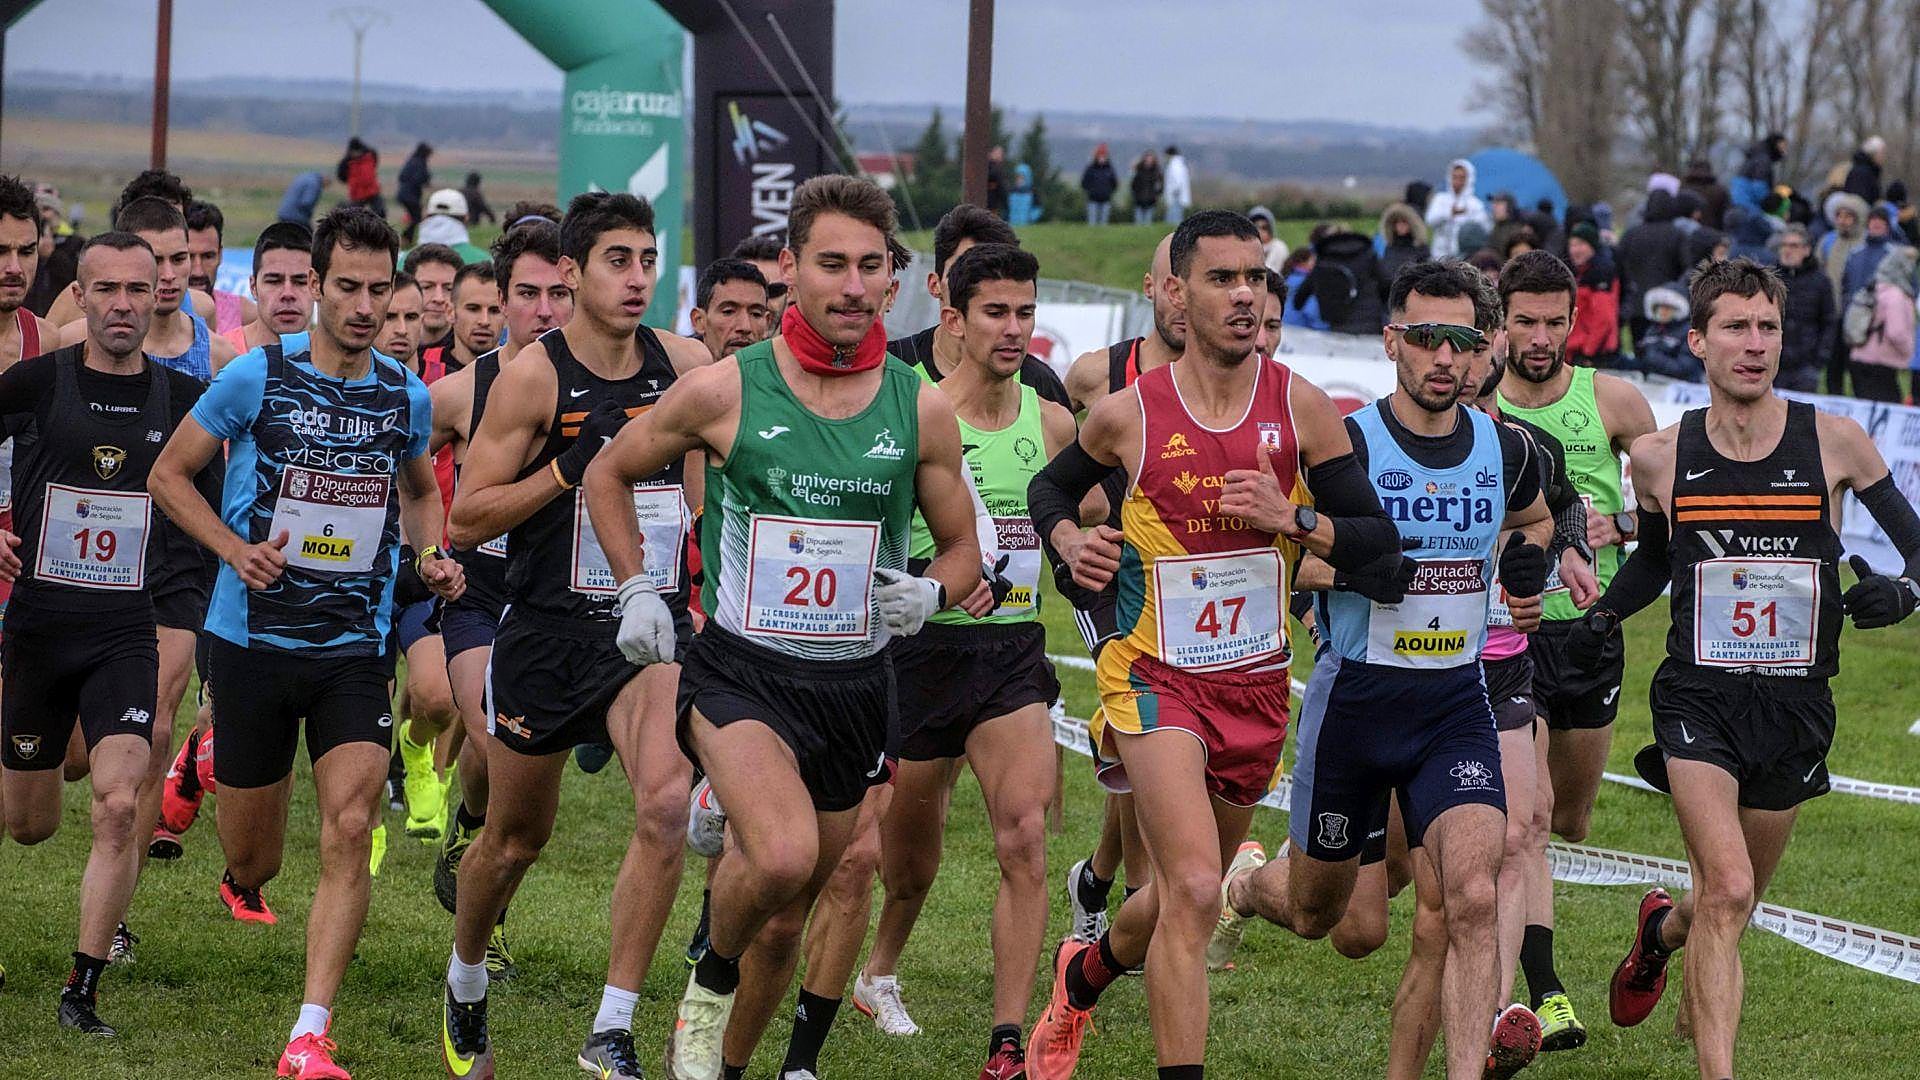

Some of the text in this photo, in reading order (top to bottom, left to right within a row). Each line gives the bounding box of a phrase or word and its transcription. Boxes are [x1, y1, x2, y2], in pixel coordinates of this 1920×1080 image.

[751, 163, 795, 238] VEN
[289, 407, 331, 428] ada
[338, 416, 376, 436] TRIBE
[285, 447, 394, 473] vistasol
[313, 476, 382, 492] Diputación
[791, 473, 892, 496] universidad
[1380, 473, 1412, 489] TROPS
[311, 488, 380, 506] de Segovia
[791, 486, 841, 507] de león
[91, 504, 122, 513] Diputación
[1382, 487, 1493, 531] nerja
[323, 523, 334, 537] 6
[995, 521, 1035, 534] putación
[1187, 519, 1212, 534] DE
[74, 528, 116, 562] 19
[302, 541, 351, 557] MOLA
[806, 537, 843, 546] Diputación
[999, 534, 1035, 549] Segovia
[1739, 537, 1799, 551] VICKY
[805, 547, 842, 556] de Segovia
[60, 561, 83, 570] CROSS
[85, 563, 121, 573] NACIONAL
[1208, 567, 1246, 580] Diputación
[49, 568, 131, 583] CANTIMPALOS 2023
[1209, 576, 1247, 588] de Segovia
[1749, 573, 1785, 582] Diputación
[784, 566, 837, 607] 20
[1430, 578, 1481, 593] Segovia
[1759, 582, 1784, 591] Segovia
[1006, 592, 1032, 603] ANA
[761, 609, 856, 621] LI CROSS NACIONAL DE
[1195, 596, 1246, 638] 47
[1732, 601, 1776, 637] 51
[759, 619, 857, 632] CANTIMPALOS 2023
[1428, 616, 1440, 630] 4
[1177, 633, 1270, 655] LI CROSS NACIONAL DE
[1394, 636, 1465, 650] AOUINA
[1749, 641, 1789, 649] NACIONAL
[1177, 641, 1272, 666] CANTIMPALOS 2023
[1710, 650, 1801, 660] CANTIMPALOS 2023
